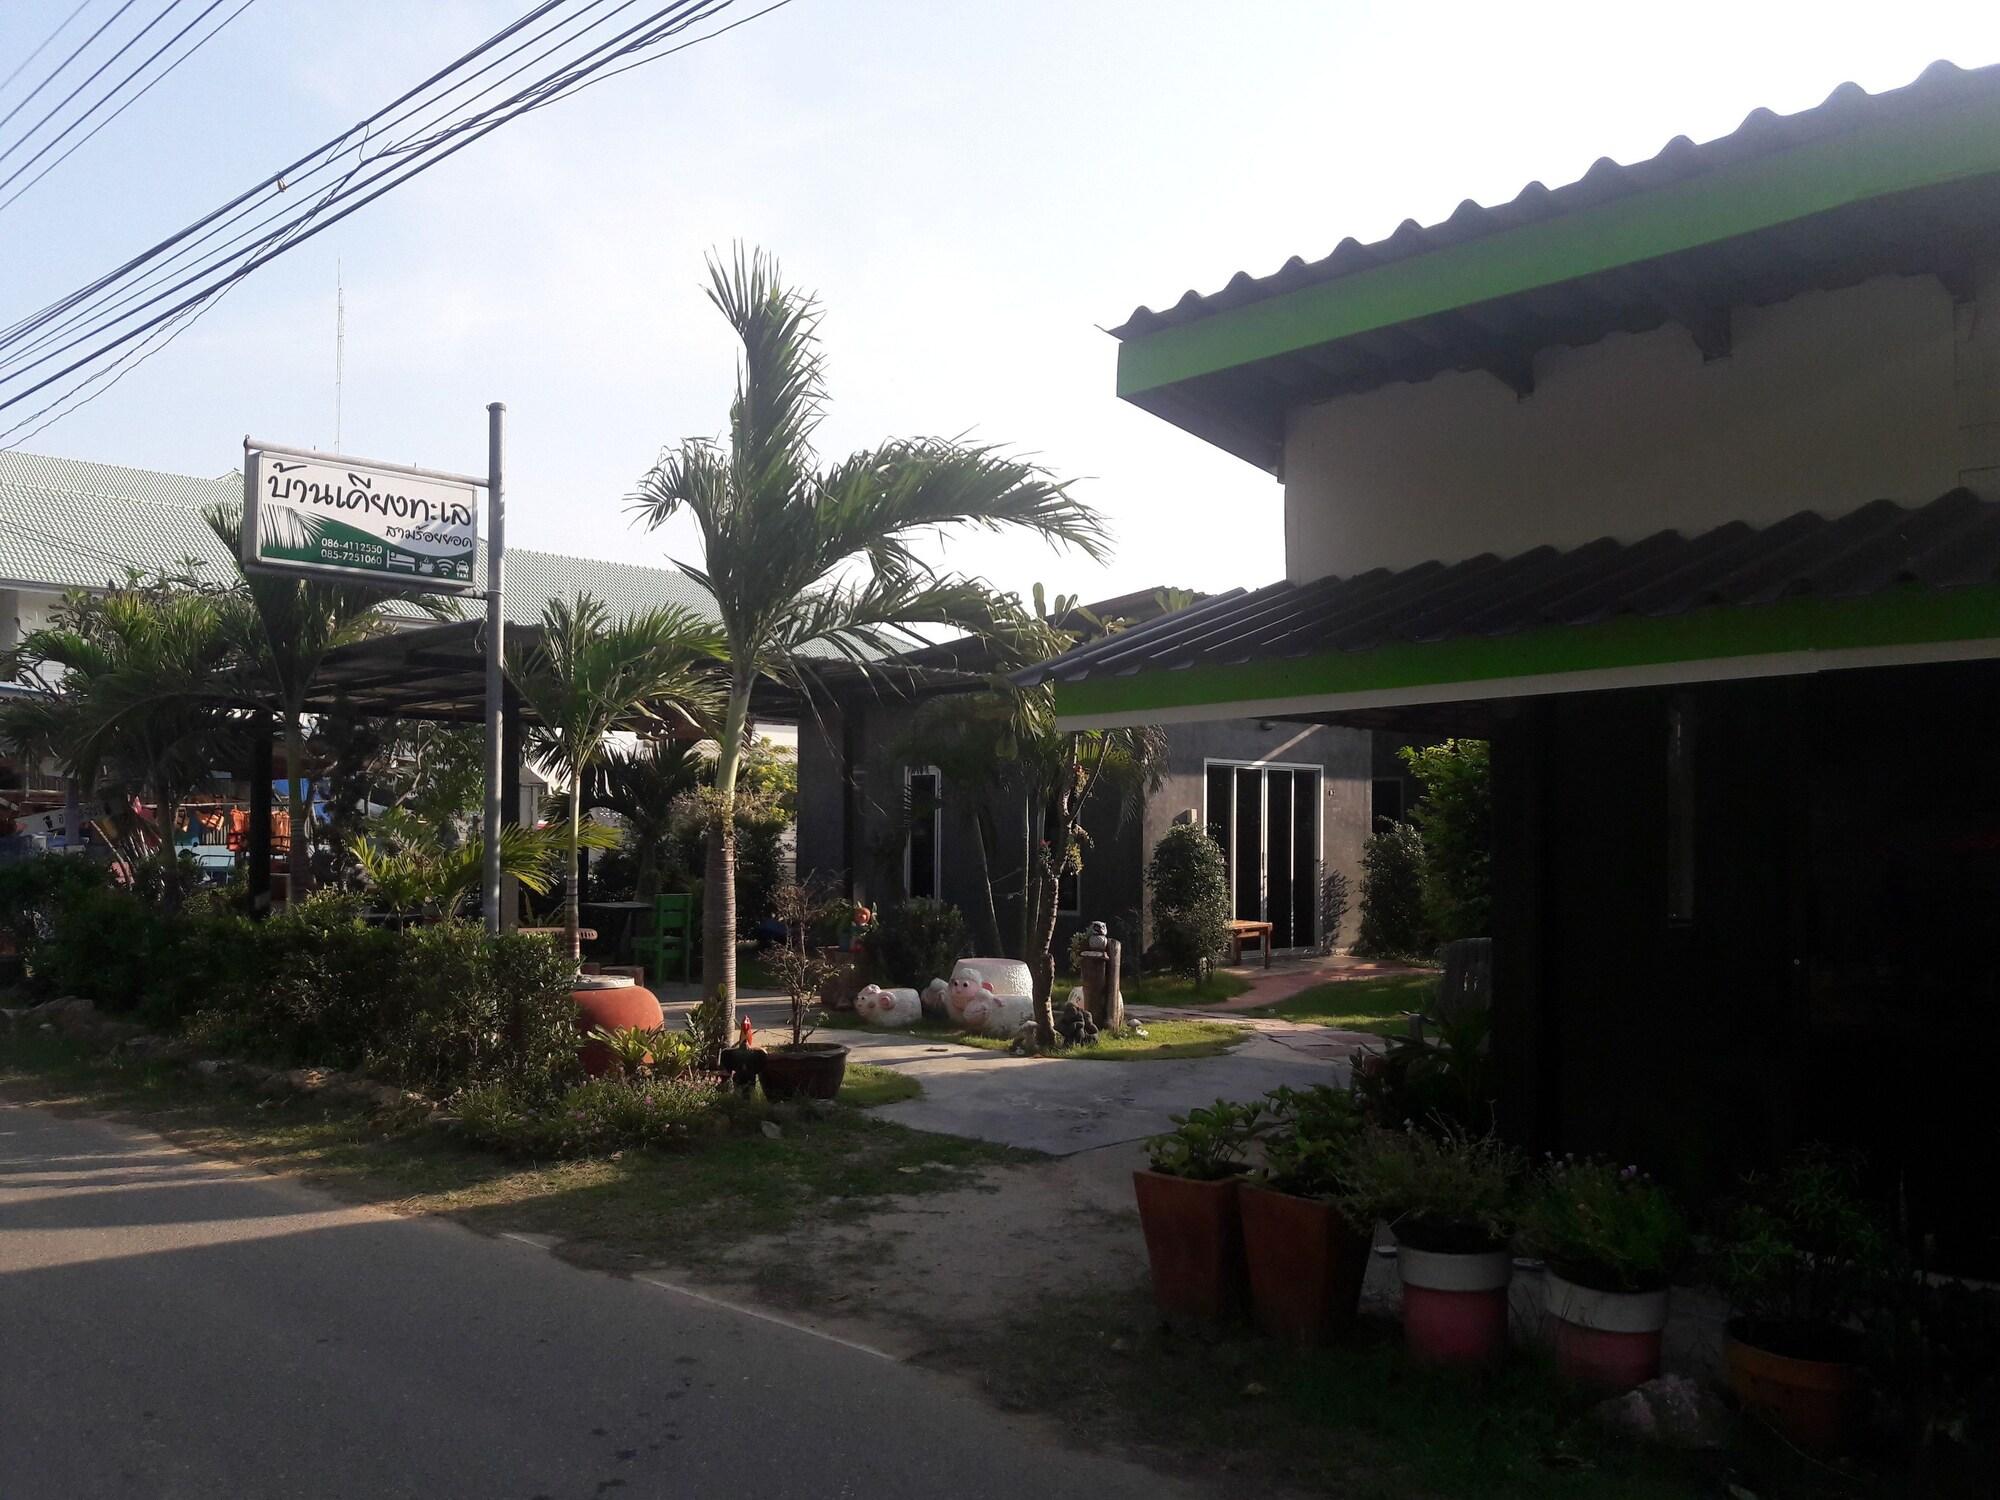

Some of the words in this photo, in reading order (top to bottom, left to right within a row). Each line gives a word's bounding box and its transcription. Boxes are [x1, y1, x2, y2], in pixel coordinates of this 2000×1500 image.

[268, 462, 472, 526] บ้านเคียงทะเล
[321, 537, 383, 554] 086-4112550
[386, 525, 473, 549] สามร้อยยอด
[321, 549, 382, 565] 085-7251060
